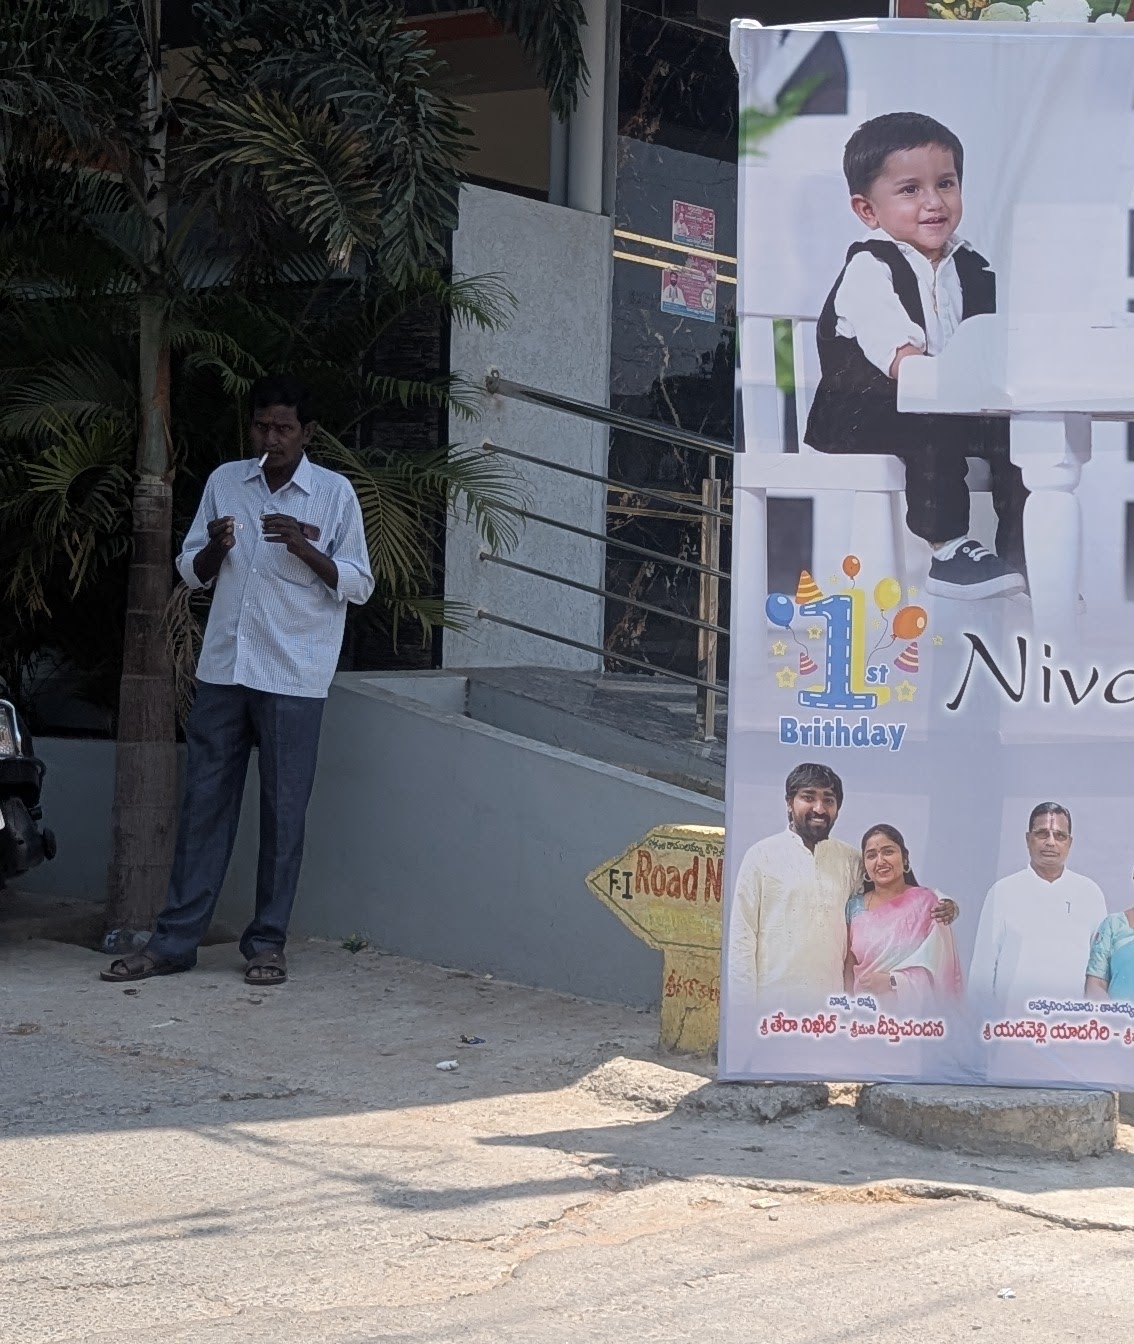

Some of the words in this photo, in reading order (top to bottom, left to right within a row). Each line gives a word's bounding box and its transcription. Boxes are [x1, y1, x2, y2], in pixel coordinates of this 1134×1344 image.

[779, 717, 907, 751] Brithday
[635, 850, 700, 903] Road
[704, 857, 723, 903] N
[829, 996, 850, 1010] నాన్న
[857, 996, 877, 1011] అమ్మ
[1099, 1002, 1134, 1019] తాతయ్య
[801, 1014, 837, 1038] నిఖిల్
[850, 1021, 875, 1037] శ్రీమతి
[1050, 1019, 1110, 1041] యాదగిరి
